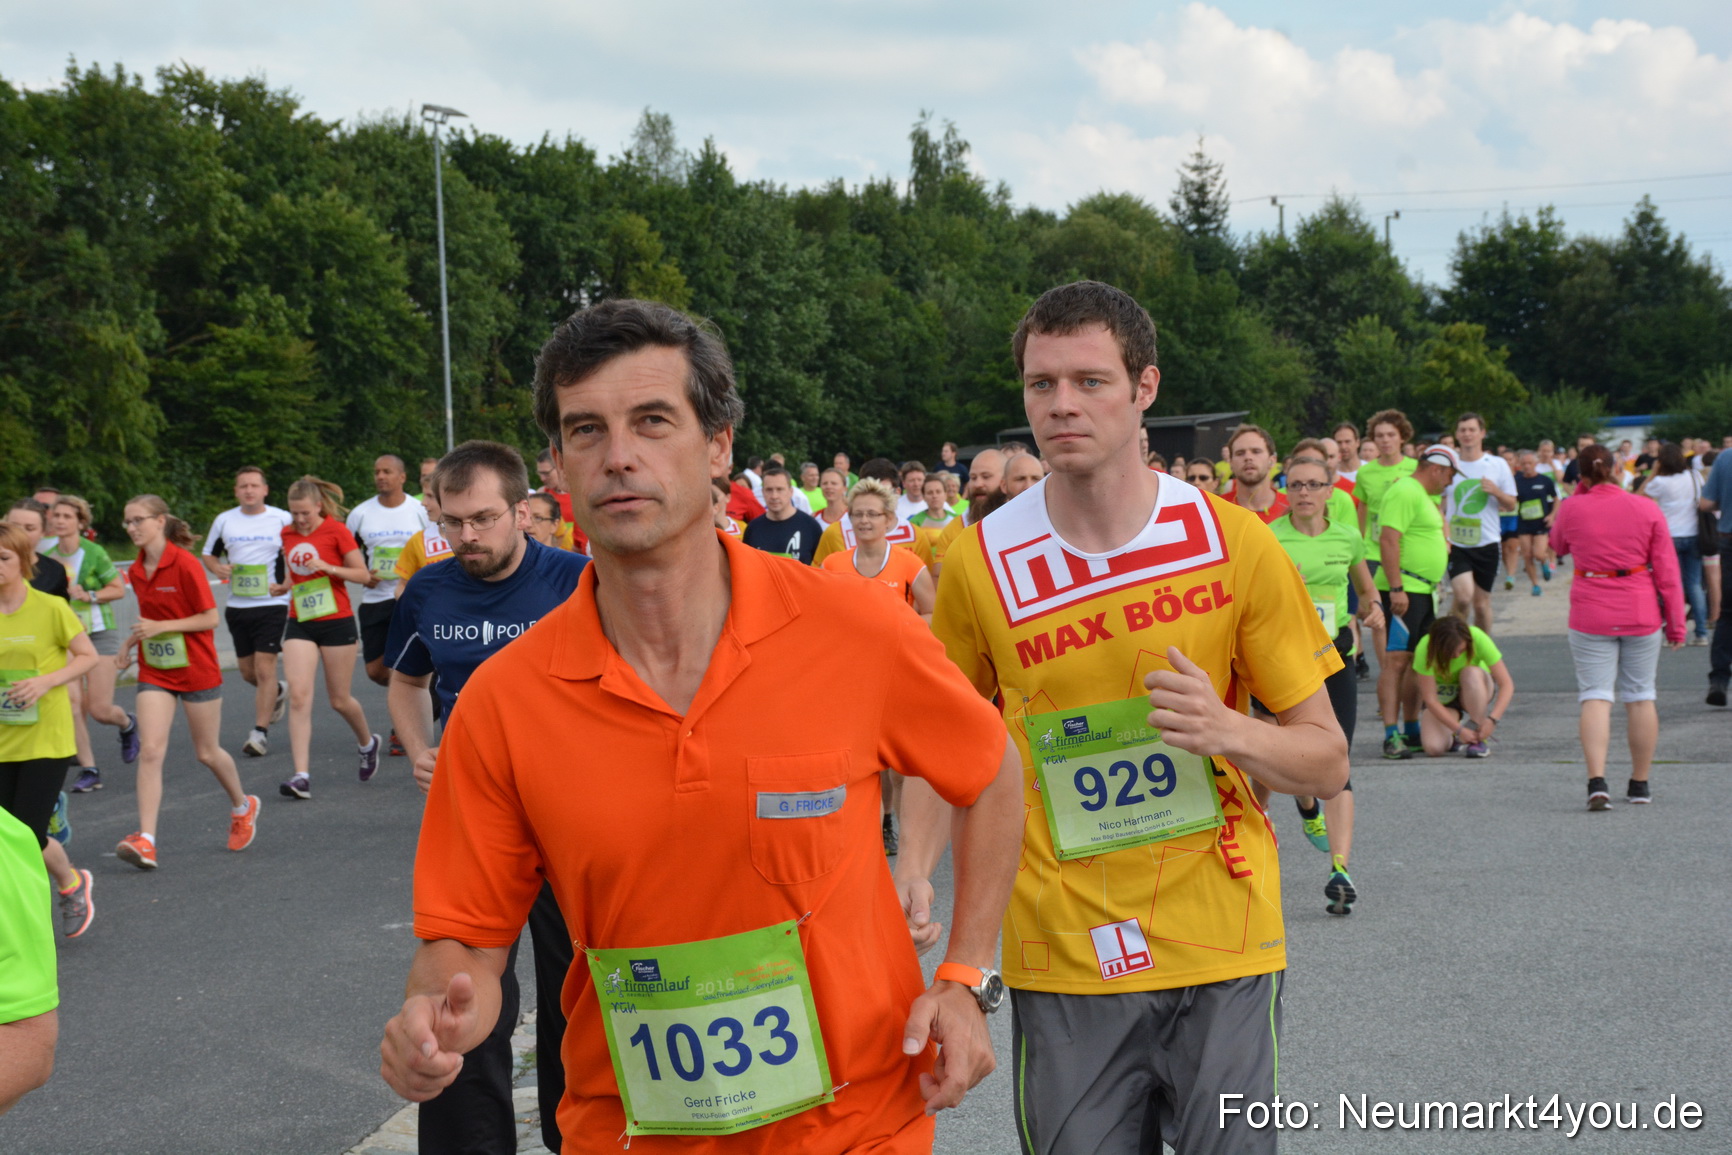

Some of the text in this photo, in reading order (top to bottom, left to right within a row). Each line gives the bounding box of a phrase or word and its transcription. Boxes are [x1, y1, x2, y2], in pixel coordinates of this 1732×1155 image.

[368, 530, 413, 538] DELPHI
[237, 577, 260, 588] 283
[302, 593, 324, 609] 497
[434, 624, 479, 640] EURO
[1015, 580, 1233, 669] MAX BÖGL
[148, 642, 176, 657] 506
[1056, 727, 1113, 747] firmenlauf
[1116, 728, 1148, 743] 2016
[1074, 752, 1177, 812] 929
[1098, 809, 1172, 831] Nico Hartmann
[624, 976, 691, 993] firmenlauf
[696, 977, 735, 997] 2016
[630, 1006, 799, 1082] 1033
[684, 1090, 757, 1108] Gerd Fricke
[692, 1105, 754, 1119] PEKU-Folien GmbH
